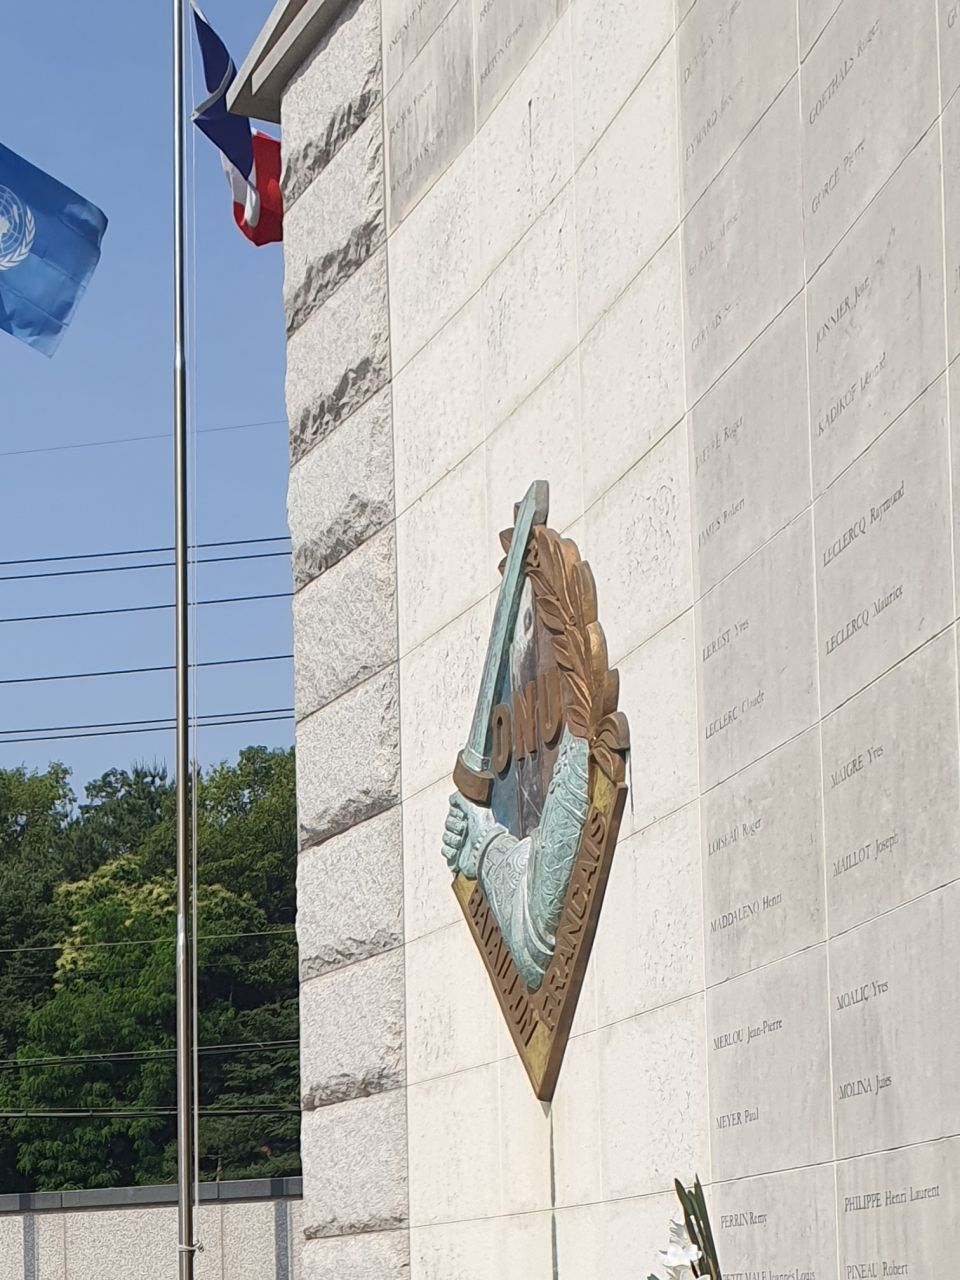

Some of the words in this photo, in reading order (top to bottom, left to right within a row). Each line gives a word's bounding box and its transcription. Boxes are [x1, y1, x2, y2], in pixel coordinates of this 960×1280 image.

[823, 516, 866, 567] LECLERCQ
[734, 619, 749, 637] Yves
[826, 609, 869, 656] LECLERCQ
[872, 585, 903, 617] Maurice
[492, 667, 563, 775] ONU
[705, 706, 738, 740] LECLERC
[741, 689, 765, 714] Claude
[831, 753, 864, 789] MAIGRE
[867, 744, 884, 765] Yves
[742, 818, 762, 837] Roger
[833, 844, 872, 878] MAILLOT
[874, 832, 899, 862] Joseph
[762, 891, 782, 911] Henri
[468, 887, 540, 1048] BATAILLON
[836, 984, 869, 1011] MOALIC
[871, 980, 889, 998] Yves
[713, 1028, 744, 1051] MERLOU
[746, 1019, 783, 1045] Jean-Pierre
[839, 1077, 873, 1100] MOLINA
[715, 1111, 743, 1130] MEYER
[744, 1106, 759, 1124] Paul
[844, 1192, 882, 1213] PHILIPPE
[884, 1188, 907, 1207] Henri
[909, 1185, 941, 1203] Laurent
[720, 1212, 749, 1229] PERRIN
[846, 1262, 878, 1280] PINEAU
[882, 1260, 909, 1277] Robert
